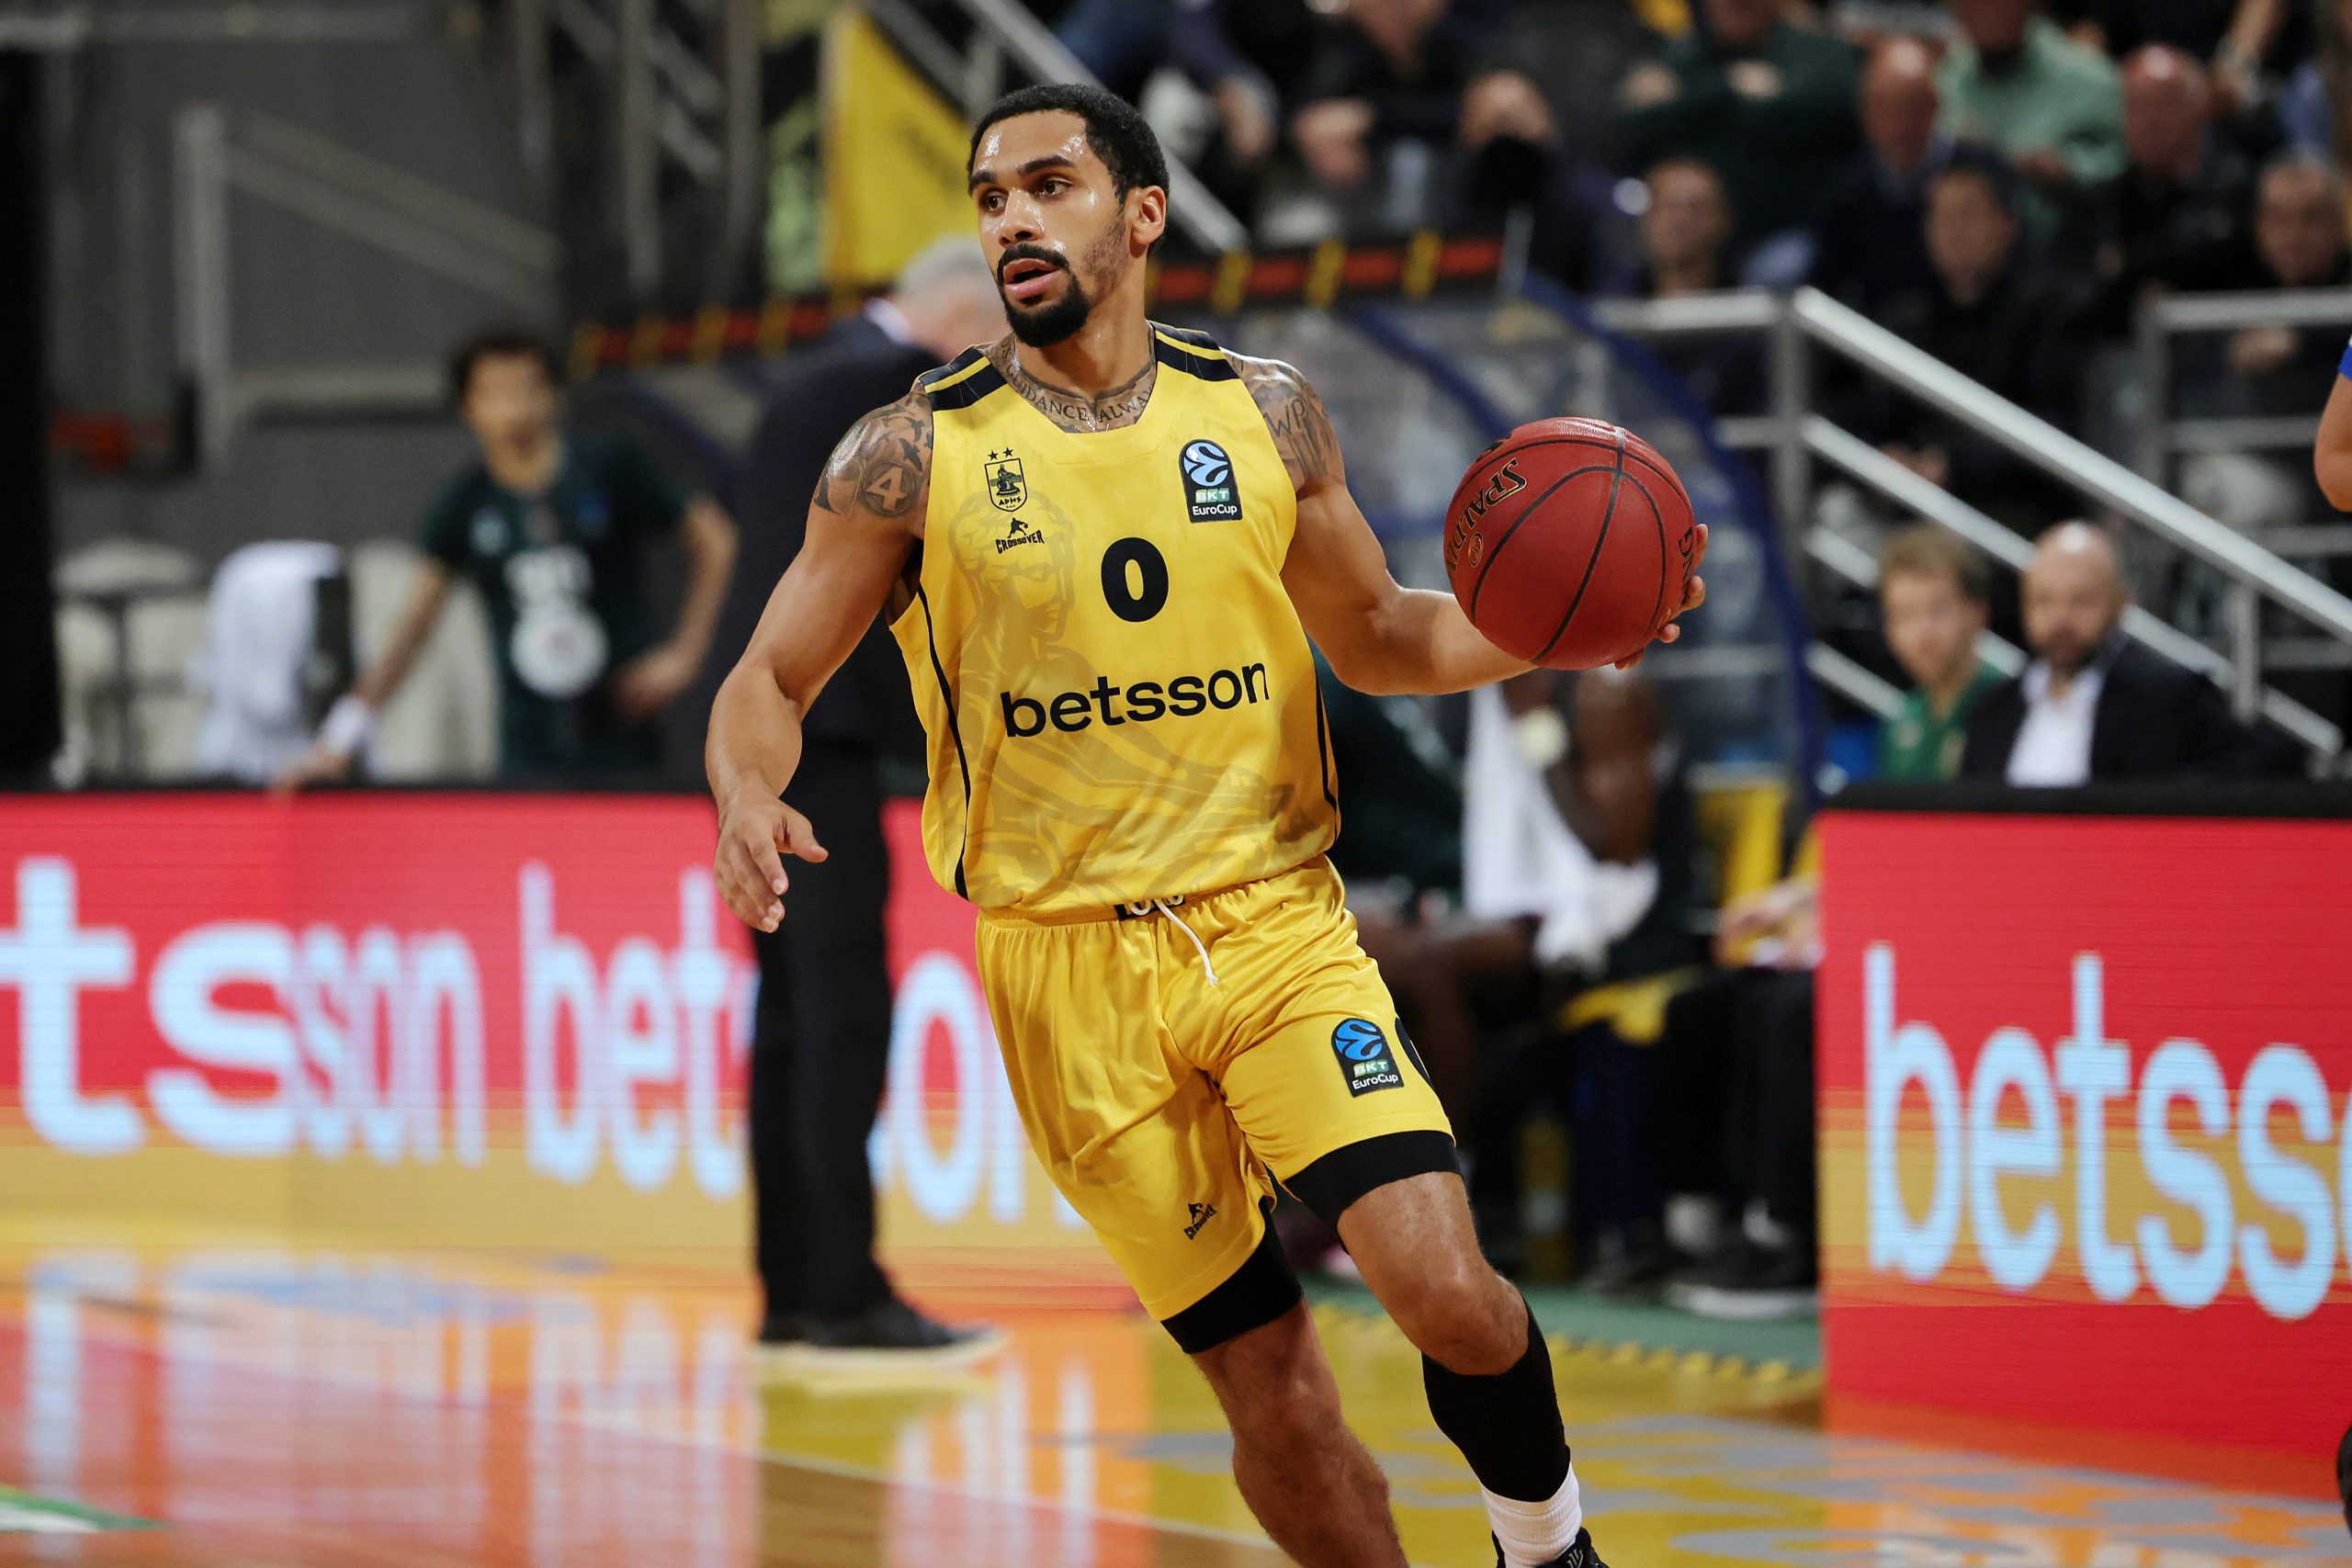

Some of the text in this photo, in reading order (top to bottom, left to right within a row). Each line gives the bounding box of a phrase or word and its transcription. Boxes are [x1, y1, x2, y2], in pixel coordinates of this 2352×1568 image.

[1195, 488, 1230, 503] BKT
[1193, 504, 1238, 515] EuroCup
[996, 530, 1045, 554] CROSSOVER
[1101, 537, 1169, 622] 0
[1001, 662, 1270, 738] betsson
[1353, 1059, 1389, 1077] BKT
[1352, 1074, 1398, 1089] EuroCup
[1862, 940, 2352, 1321] betss
